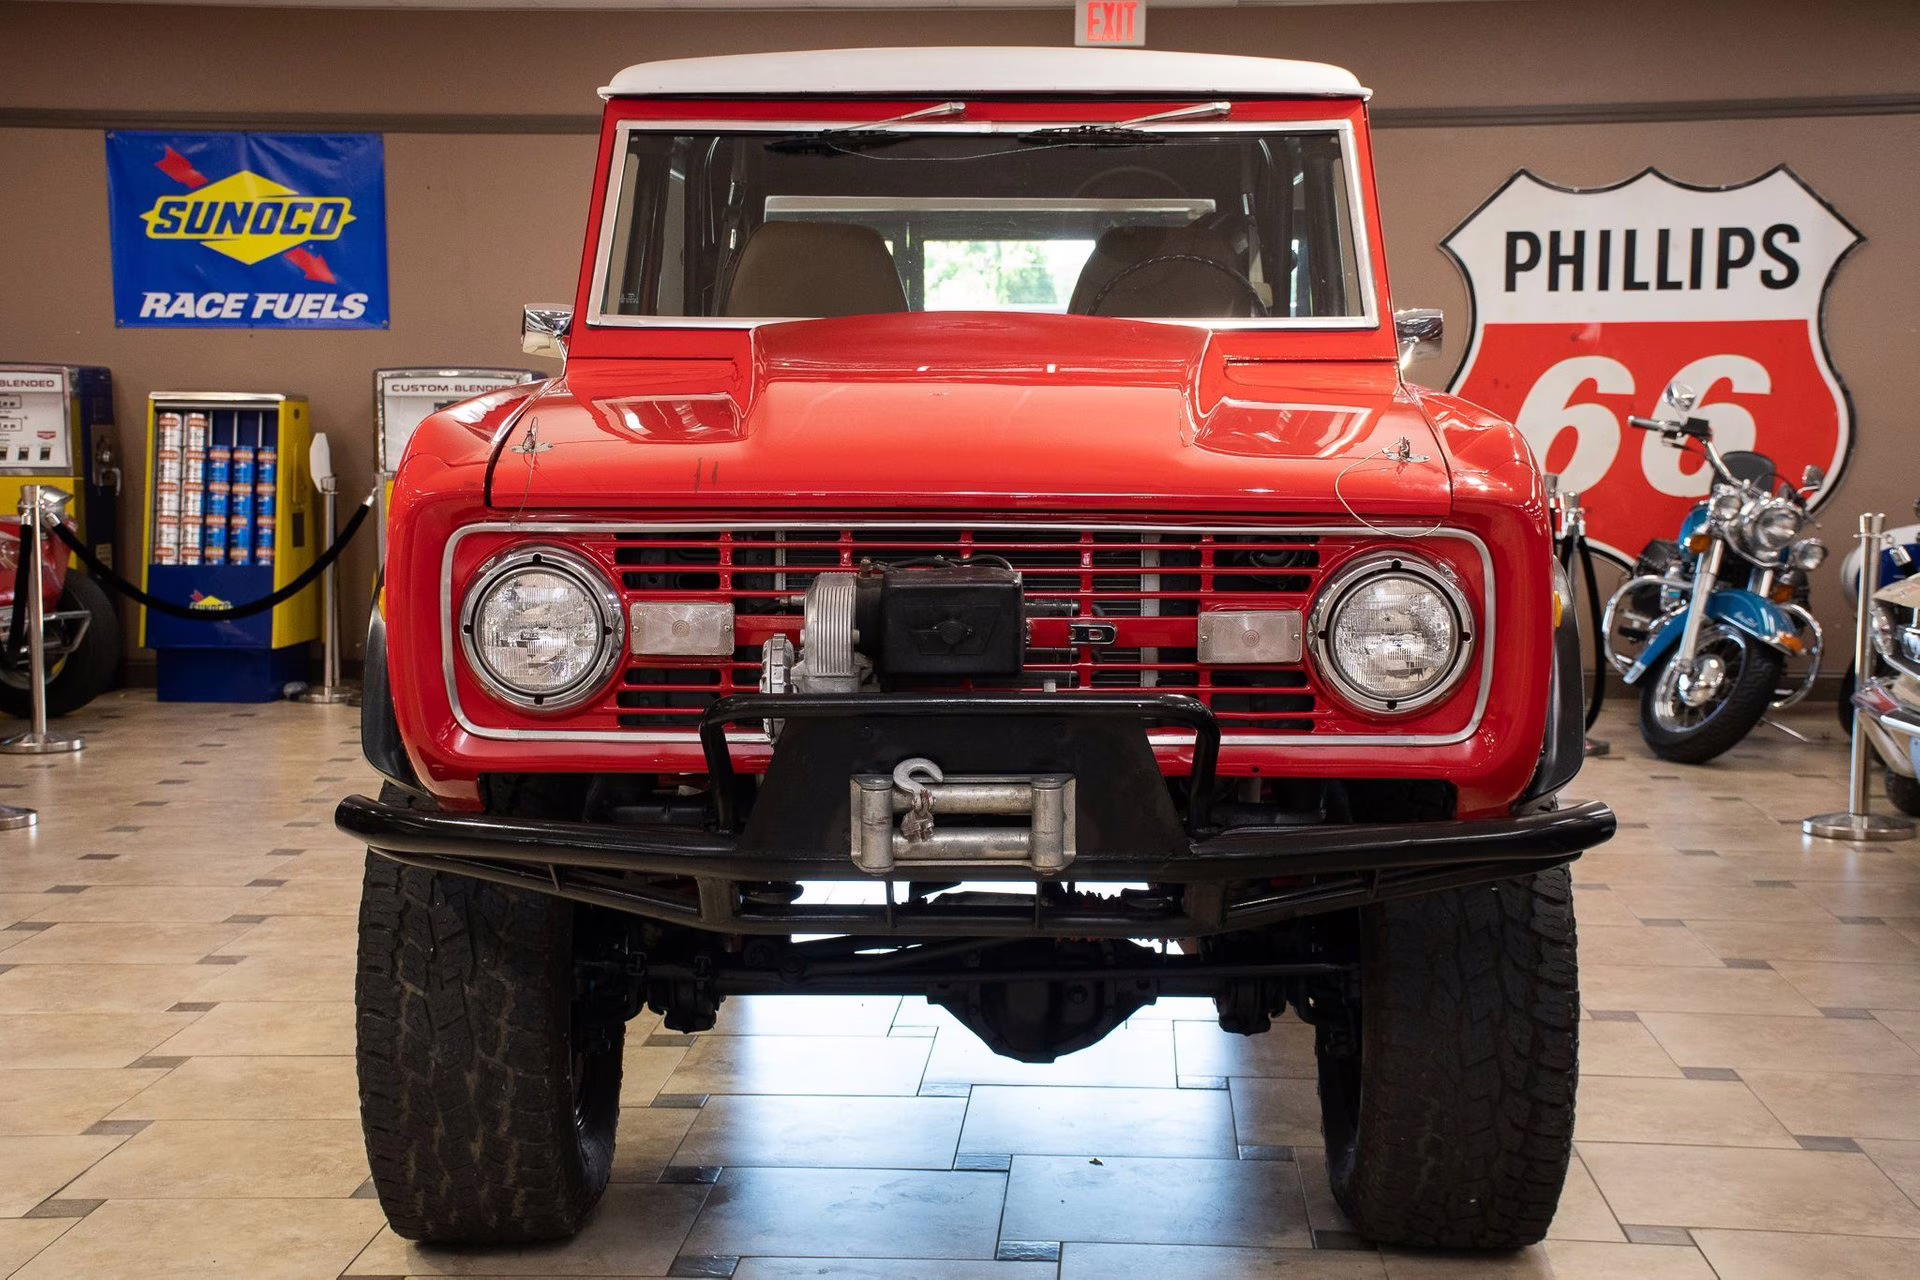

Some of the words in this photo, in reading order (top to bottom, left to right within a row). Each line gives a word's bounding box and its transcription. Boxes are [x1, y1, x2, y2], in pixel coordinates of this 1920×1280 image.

[1087, 2, 1137, 41] EXIT
[152, 201, 345, 235] SUNOCO
[1504, 223, 1801, 293] PHILLIPS
[139, 292, 249, 319] RACE
[251, 293, 369, 320] FUELS
[1514, 354, 1773, 498] 66
